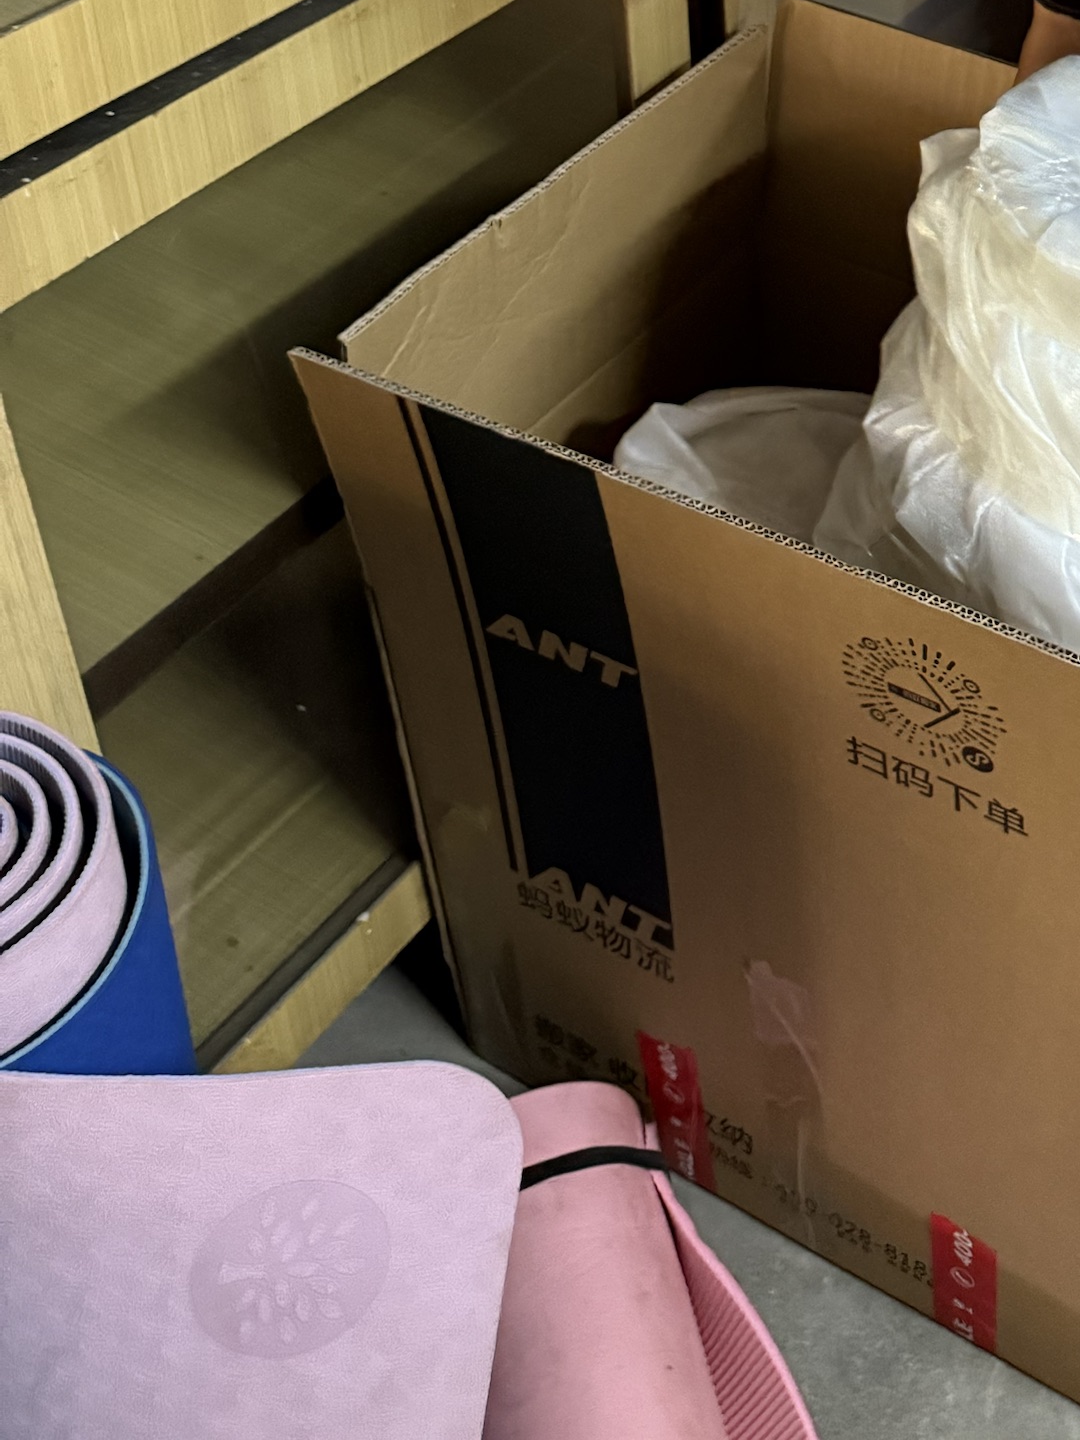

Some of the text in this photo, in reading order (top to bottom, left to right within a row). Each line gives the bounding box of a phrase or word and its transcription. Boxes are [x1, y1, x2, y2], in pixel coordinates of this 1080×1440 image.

[486, 613, 638, 689] ANT
[846, 735, 1029, 837] 扫码下单
[517, 881, 675, 983] 蚂蚁物流
[527, 865, 673, 949] ANT
